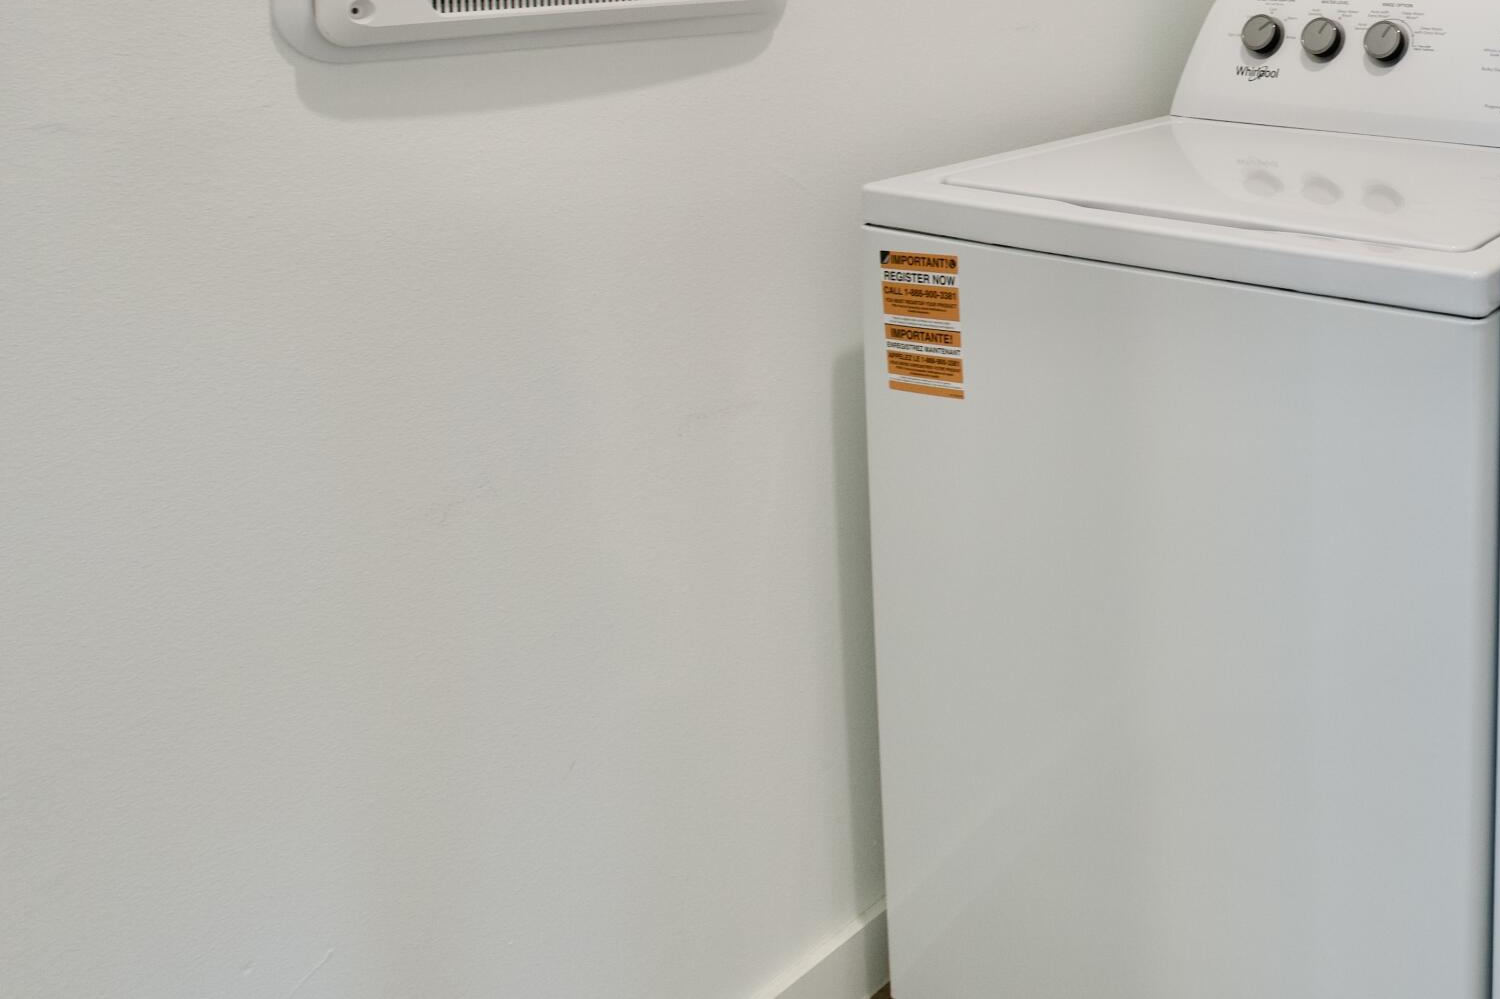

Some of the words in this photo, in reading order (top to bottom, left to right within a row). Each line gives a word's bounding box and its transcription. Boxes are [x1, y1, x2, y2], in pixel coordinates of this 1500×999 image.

[1236, 65, 1280, 81] Whirlpool
[883, 270, 930, 284] REGISTER
[933, 275, 956, 286] NOW
[883, 286, 903, 296] CALL
